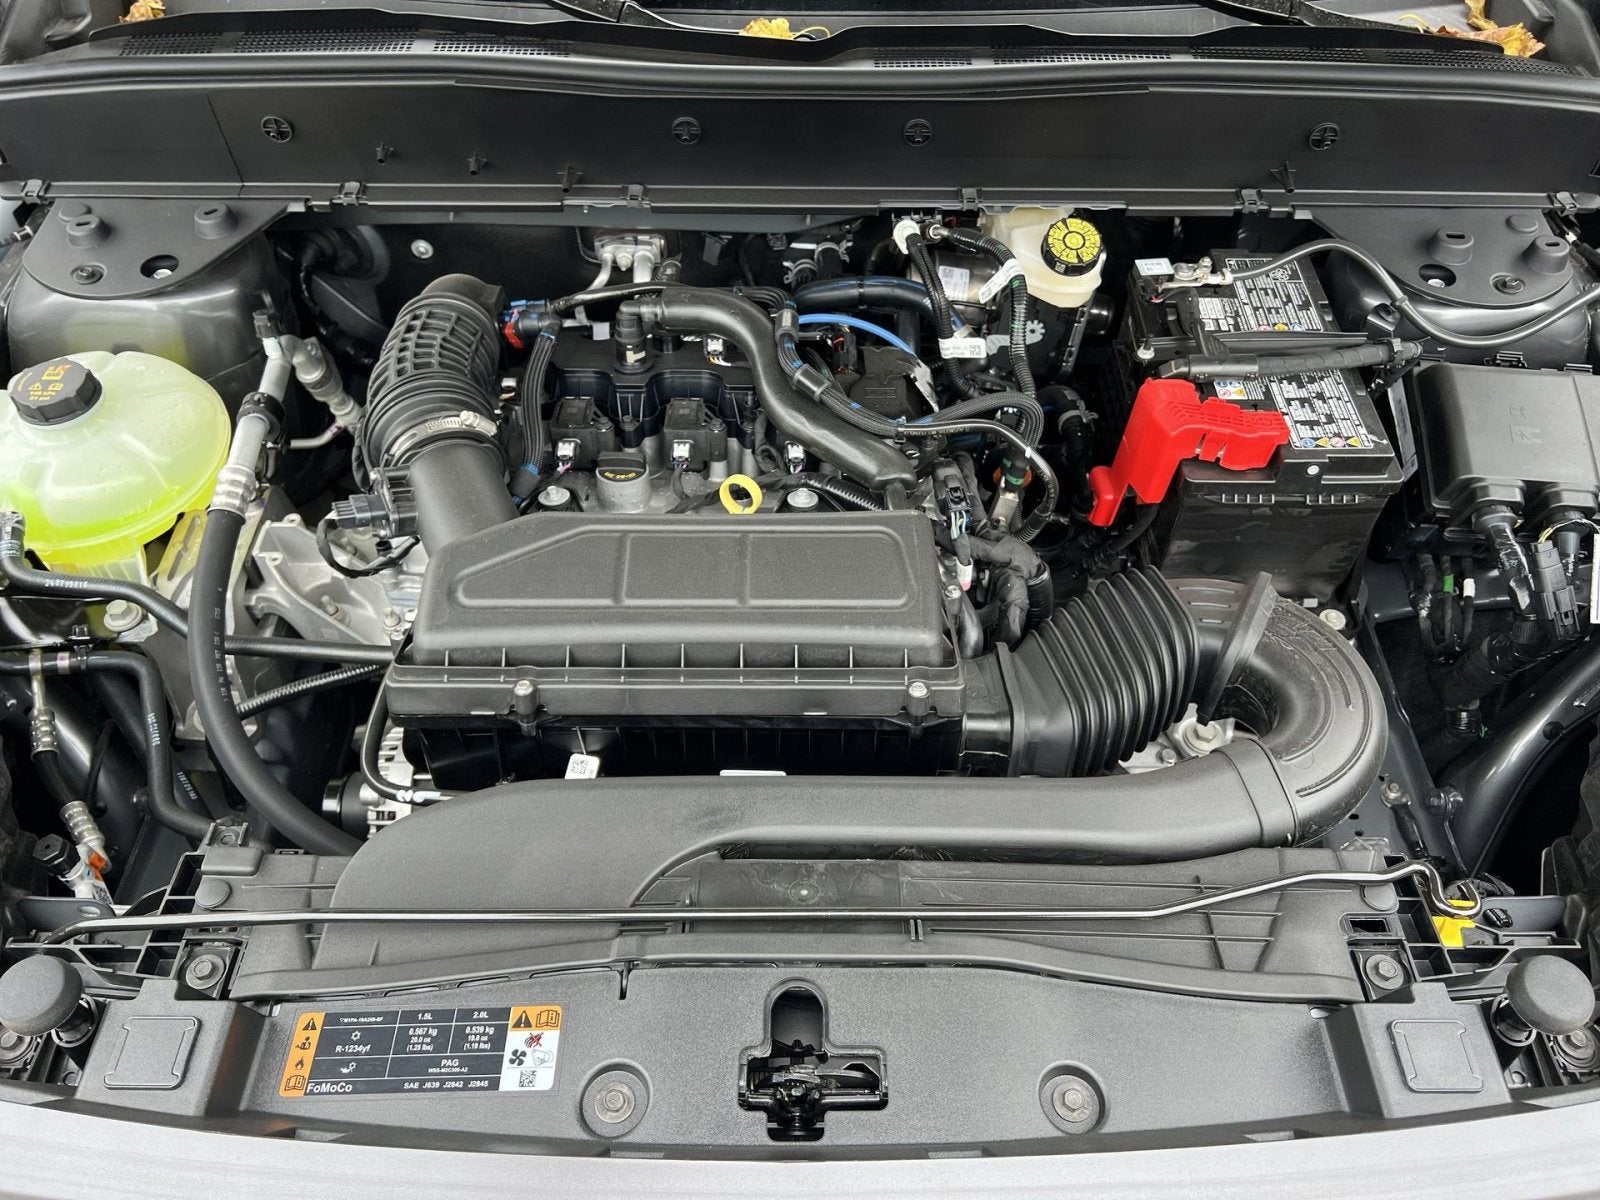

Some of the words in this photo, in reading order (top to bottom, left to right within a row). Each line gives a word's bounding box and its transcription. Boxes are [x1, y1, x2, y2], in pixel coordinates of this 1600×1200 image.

[408, 1028, 428, 1036] 0.567
[428, 1027, 438, 1037] kg
[465, 1026, 484, 1034] 0.539
[485, 1025, 495, 1035] kg
[335, 1044, 371, 1054] R-1234yf
[441, 1059, 459, 1067] PAG
[306, 1082, 353, 1093] FoMoCo
[422, 1081, 440, 1089] J639
